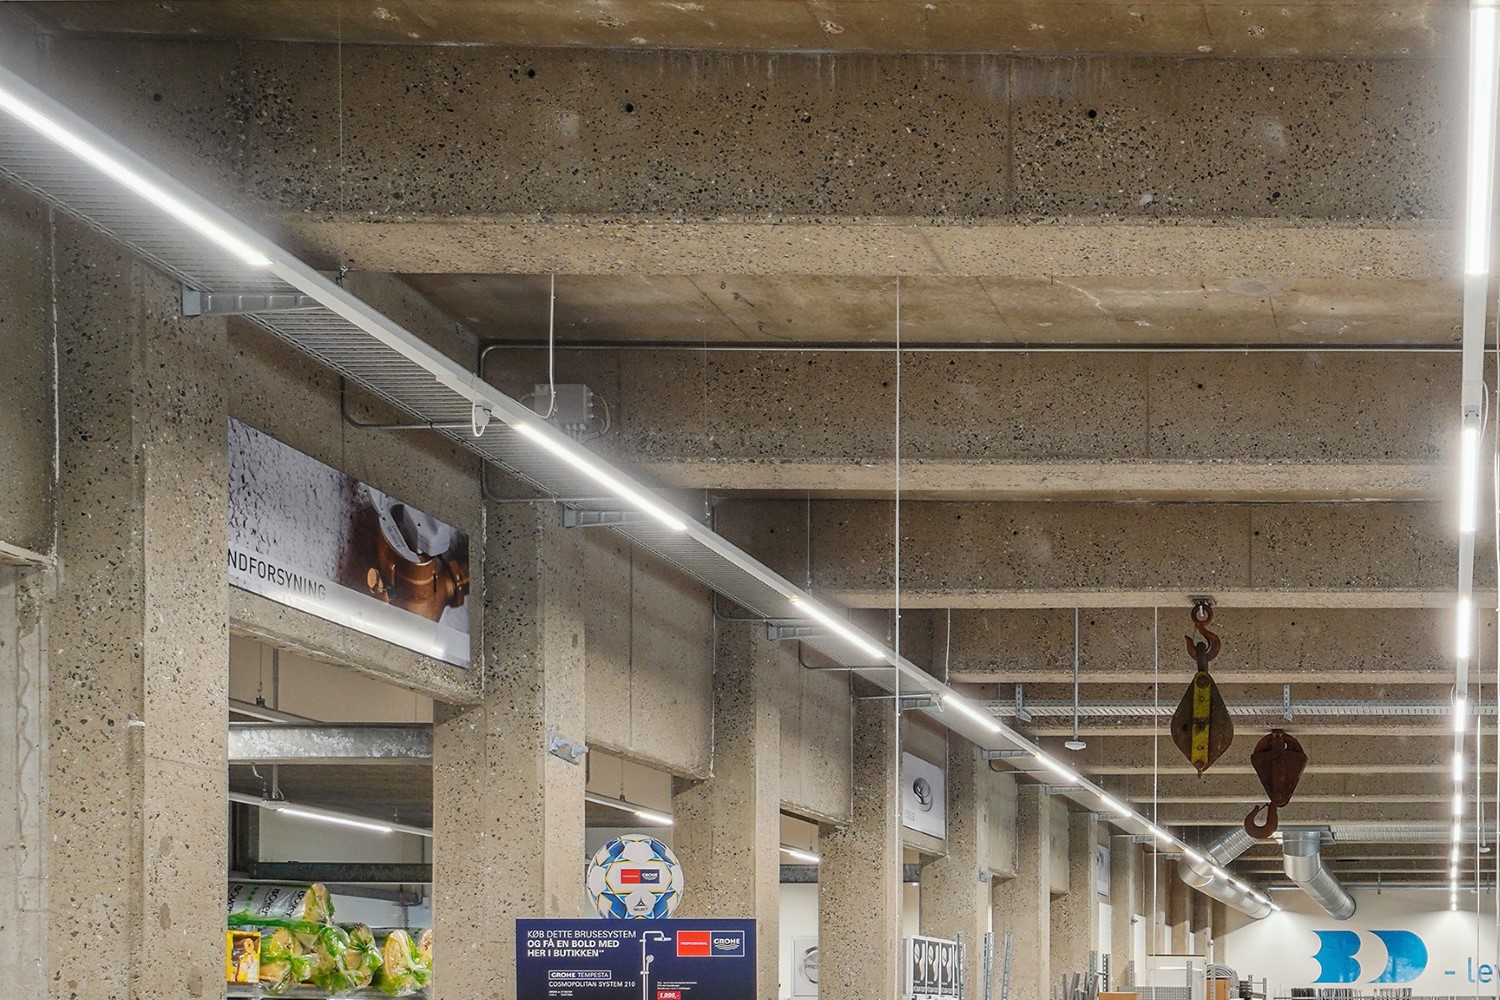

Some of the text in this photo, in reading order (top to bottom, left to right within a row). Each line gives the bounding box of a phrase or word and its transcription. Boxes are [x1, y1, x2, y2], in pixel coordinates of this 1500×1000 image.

[527, 930, 637, 938] KØB DETTE BRUSESYSTEM
[527, 938, 620, 948] OG FÅ EN BOLD MED
[527, 949, 546, 957] HER
[1312, 930, 1428, 984] BD
